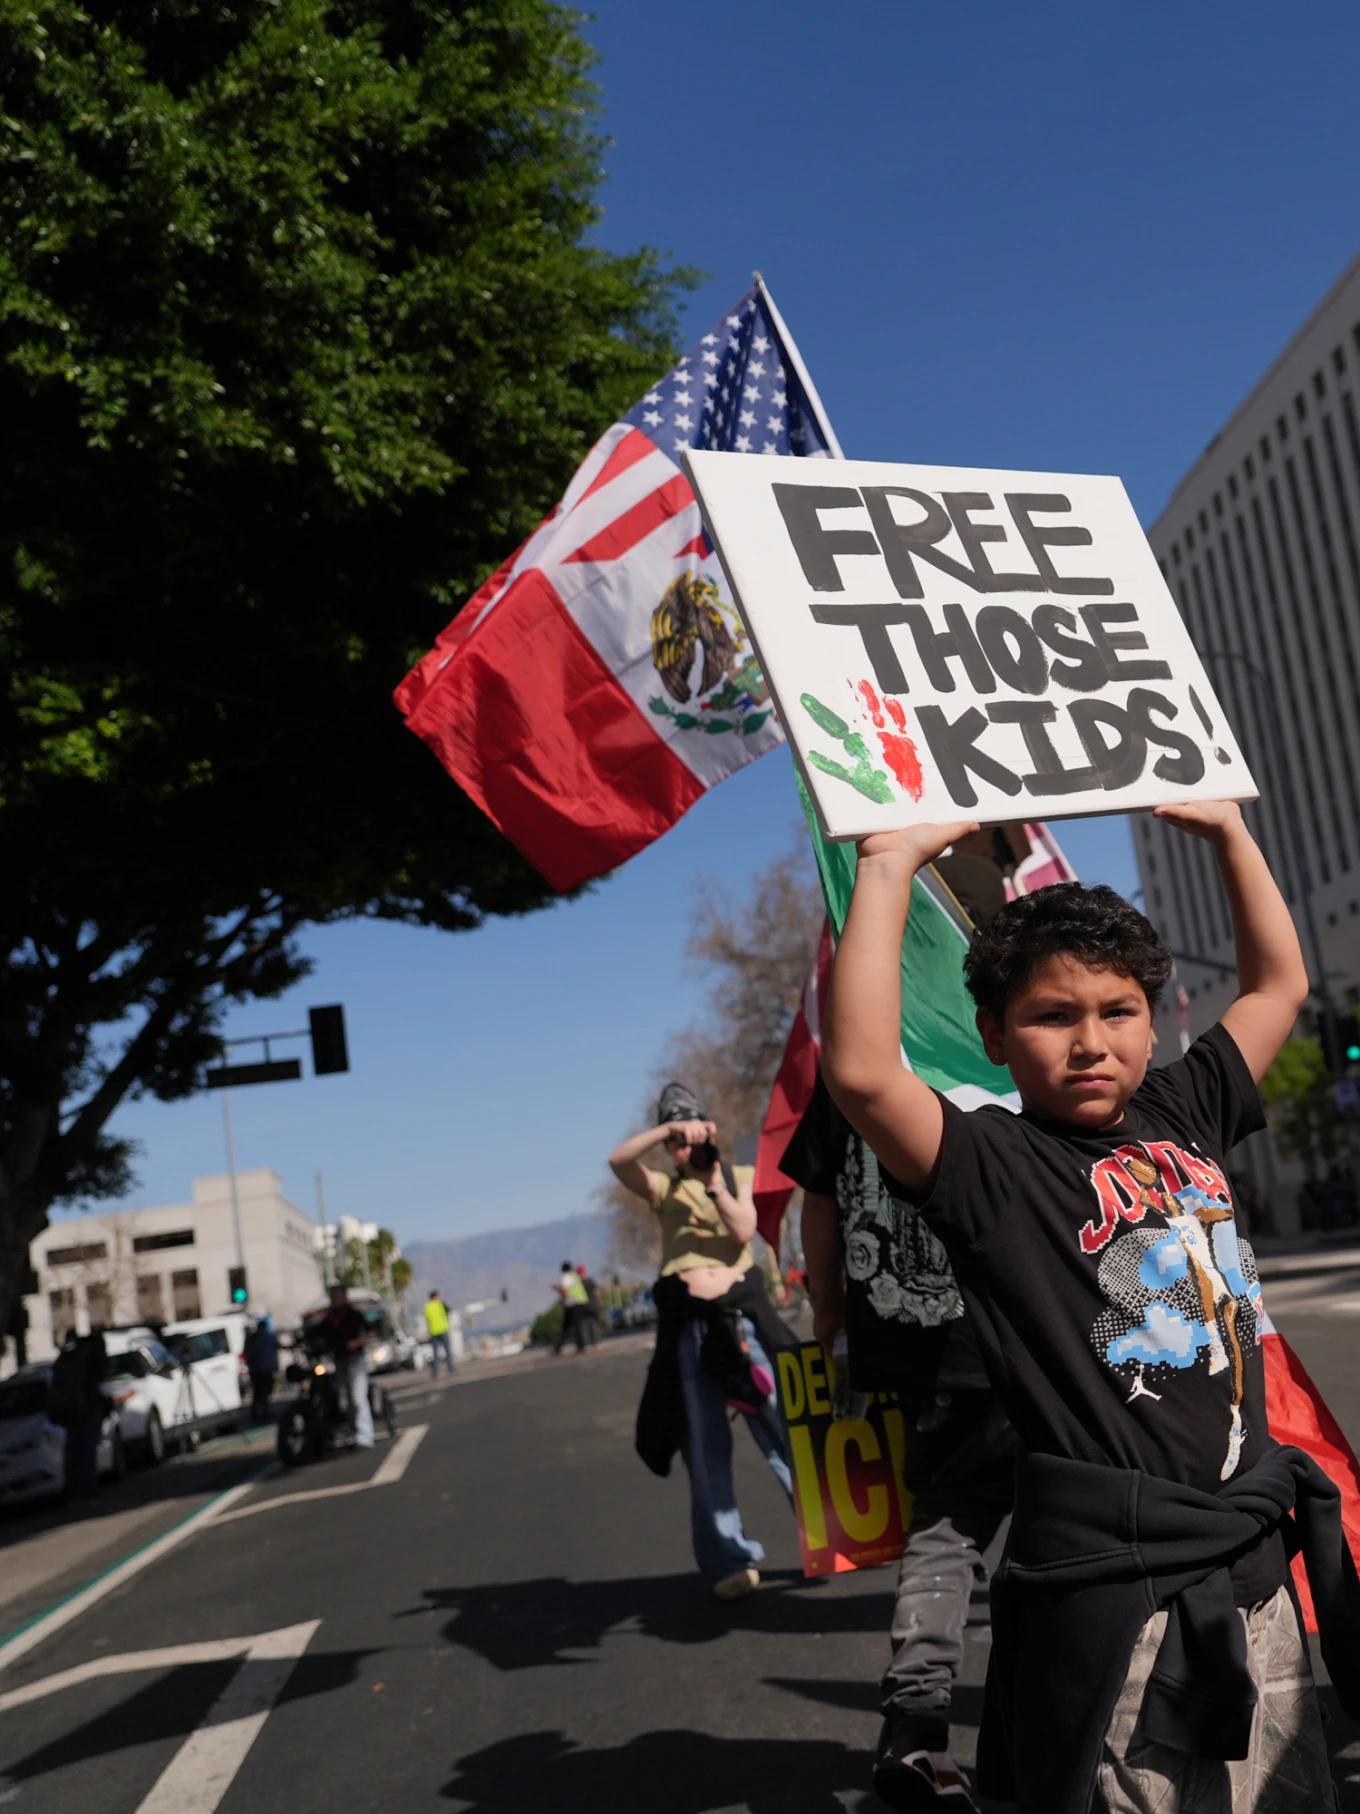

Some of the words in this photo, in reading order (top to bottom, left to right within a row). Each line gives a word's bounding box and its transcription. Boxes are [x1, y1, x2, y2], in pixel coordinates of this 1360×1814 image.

[771, 482, 1114, 599] FREE
[808, 602, 1173, 695] THOSE
[914, 684, 1232, 808] KIDS!
